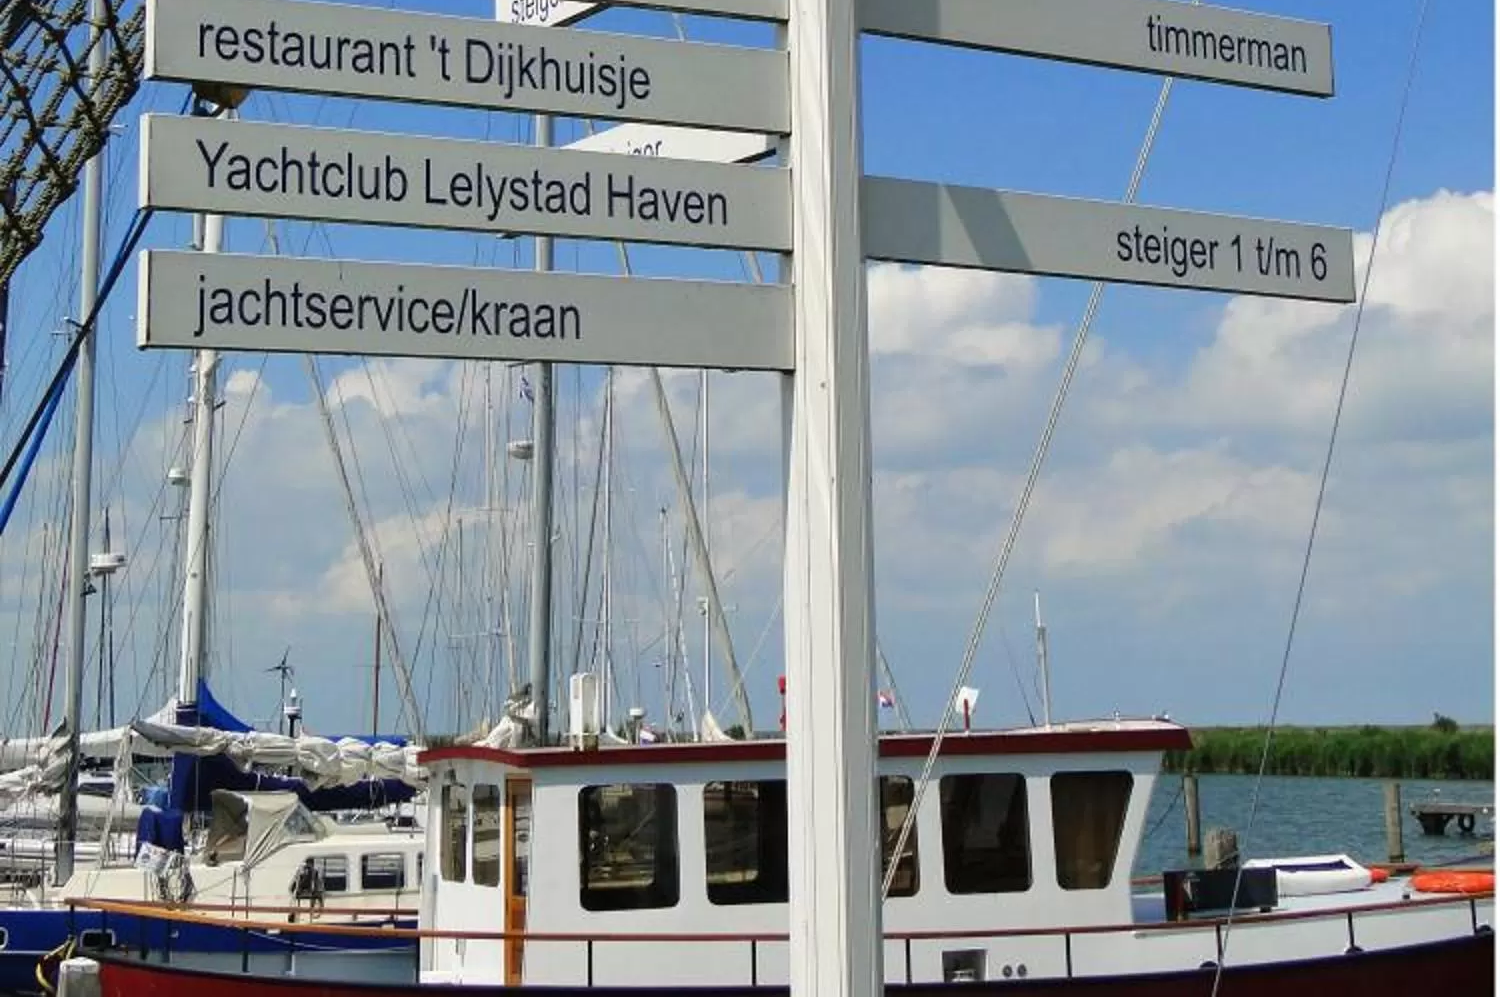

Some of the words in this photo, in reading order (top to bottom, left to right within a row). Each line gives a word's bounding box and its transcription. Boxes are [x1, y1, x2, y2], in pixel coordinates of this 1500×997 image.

[196, 19, 416, 79] restaurant
[429, 34, 451, 82] 't
[464, 39, 652, 109] Dijkhuisje
[1146, 14, 1307, 74] timmerman
[195, 138, 408, 202] Yachtclub
[425, 158, 592, 222] Lelystad
[606, 173, 729, 226] Haven
[1116, 225, 1220, 277] steiger
[1230, 234, 1242, 273] 1
[1256, 236, 1301, 279] t/m
[1310, 242, 1329, 281] 6
[193, 274, 582, 340] jachtservice/kraan
